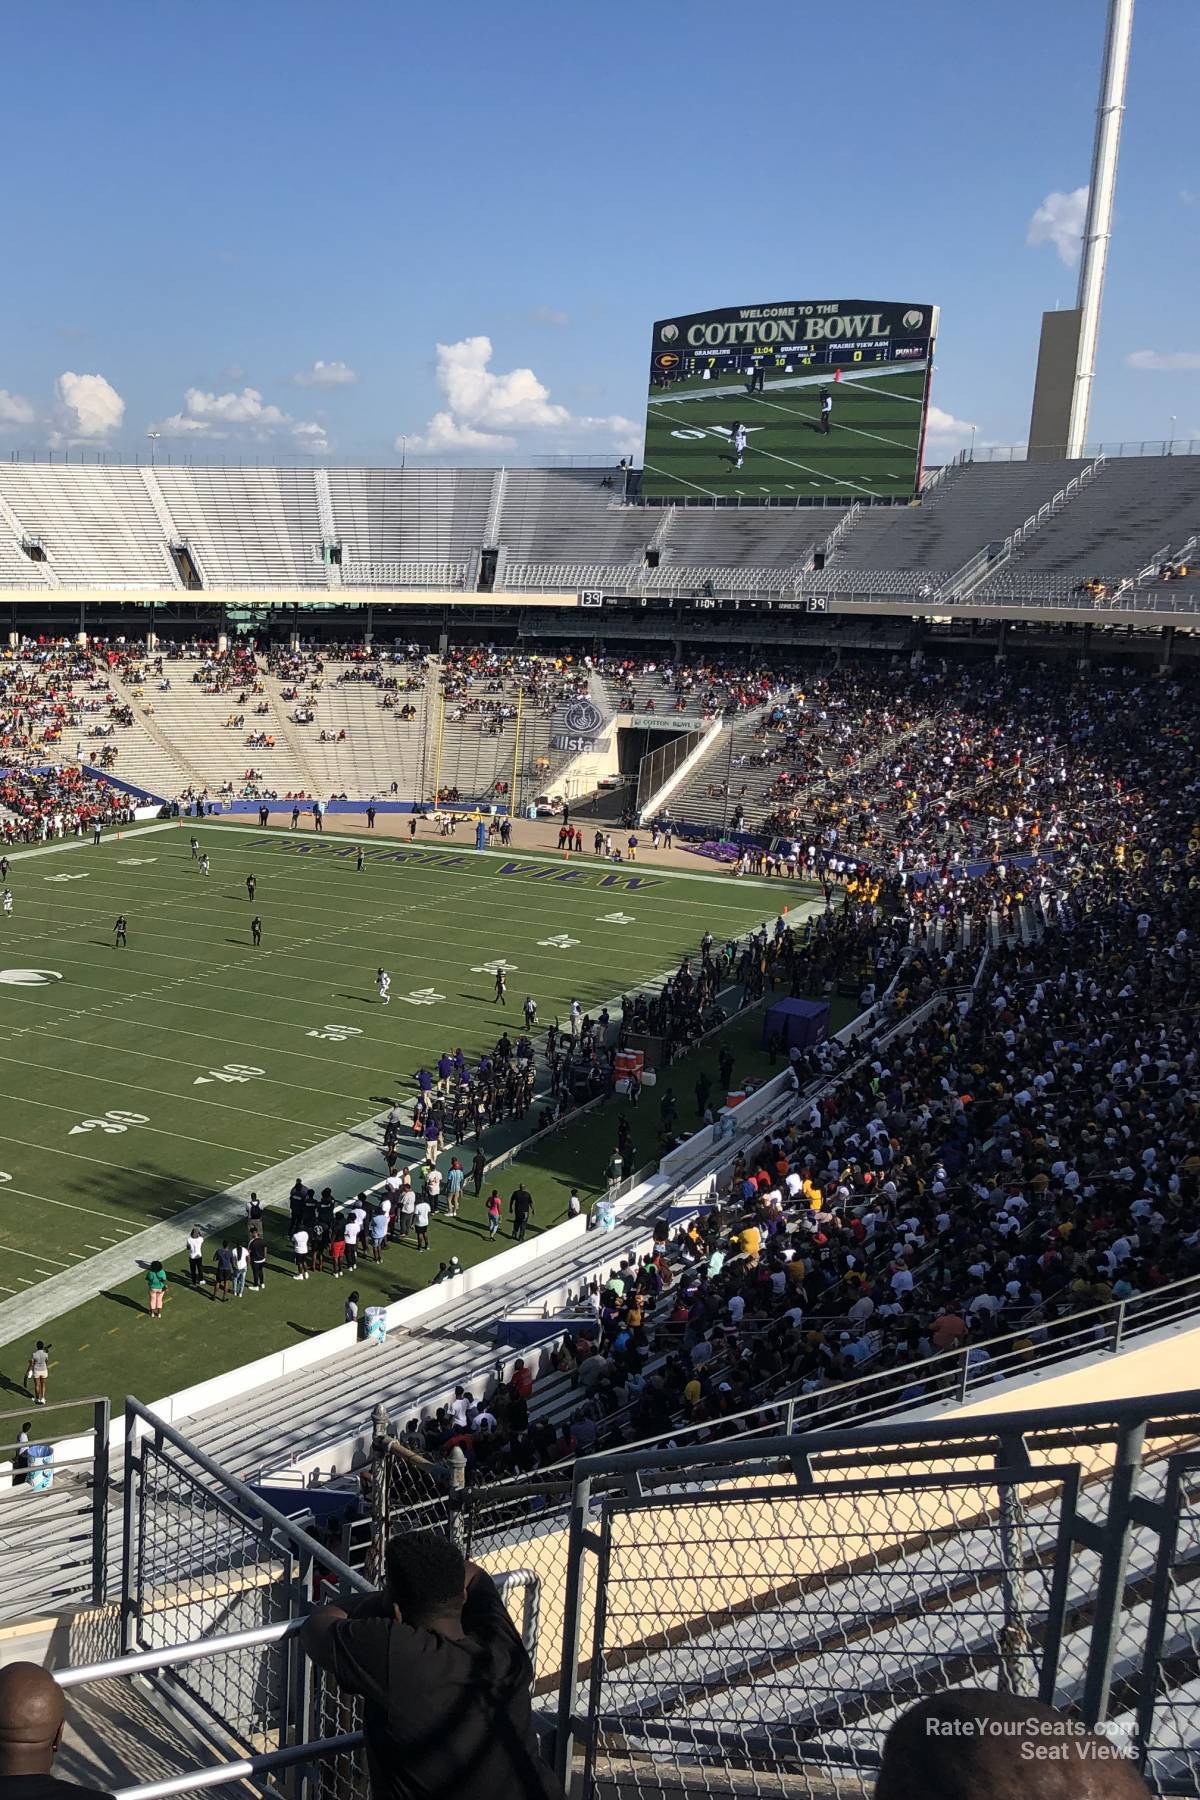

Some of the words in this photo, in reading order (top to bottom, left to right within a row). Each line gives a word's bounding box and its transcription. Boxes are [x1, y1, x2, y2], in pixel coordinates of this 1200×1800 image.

[740, 307, 795, 319] WELCOME
[798, 306, 814, 315] TO
[816, 304, 839, 314] THE
[687, 319, 800, 346] COTTON
[802, 314, 891, 340] BOWL
[856, 341, 873, 349] VIEW
[753, 347, 773, 355] 11:04
[853, 350, 862, 361] 0
[707, 358, 716, 369] 7
[775, 358, 786, 366] 10
[801, 357, 811, 365] 41
[695, 599, 715, 608] 11:04
[810, 598, 825, 610] 39
[643, 719, 670, 727] COTTON
[243, 837, 490, 870] PRAIRIE
[493, 860, 673, 892] VIEW
[306, 1024, 363, 1042] 50
[208, 1063, 267, 1084] 40
[81, 1110, 151, 1134] 30
